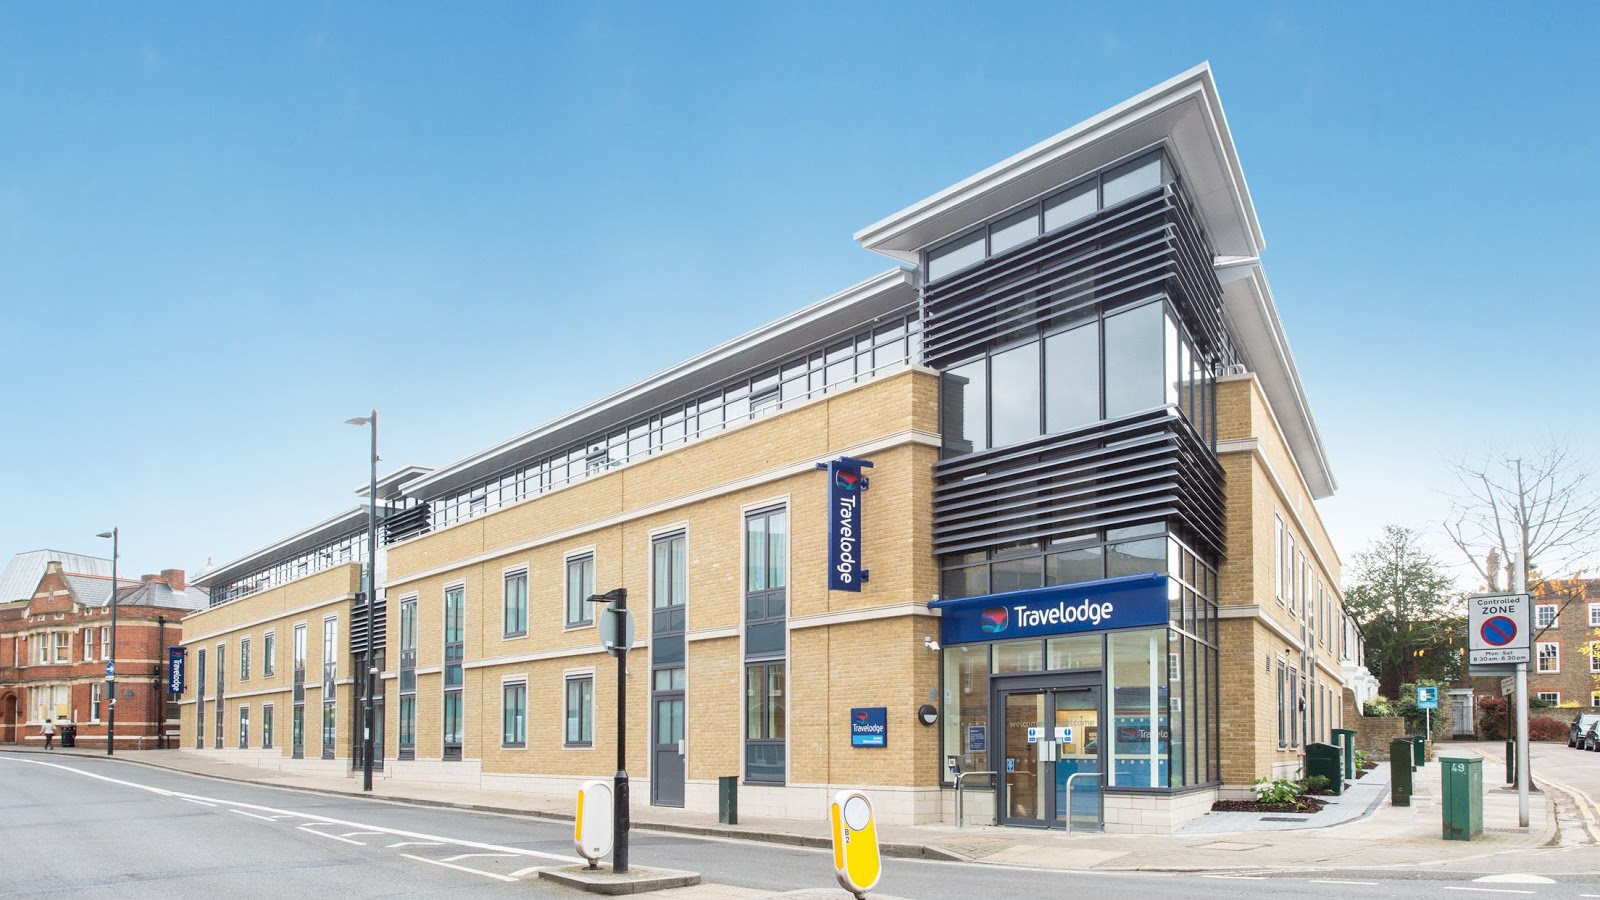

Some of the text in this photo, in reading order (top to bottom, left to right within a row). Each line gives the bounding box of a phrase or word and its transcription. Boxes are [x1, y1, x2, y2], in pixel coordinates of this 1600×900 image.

[837, 495, 855, 584] Travelodge
[1477, 597, 1520, 606] Controlled
[1013, 599, 1113, 627] Travelodge
[1482, 605, 1515, 615] ZONE
[171, 658, 182, 692] Travelodge
[1062, 719, 1095, 727] elcome
[852, 723, 884, 734] Travelodge
[1139, 729, 1168, 738] Traelo
[1451, 763, 1465, 773] 49
[844, 828, 850, 836] B
[845, 836, 850, 844] 2
